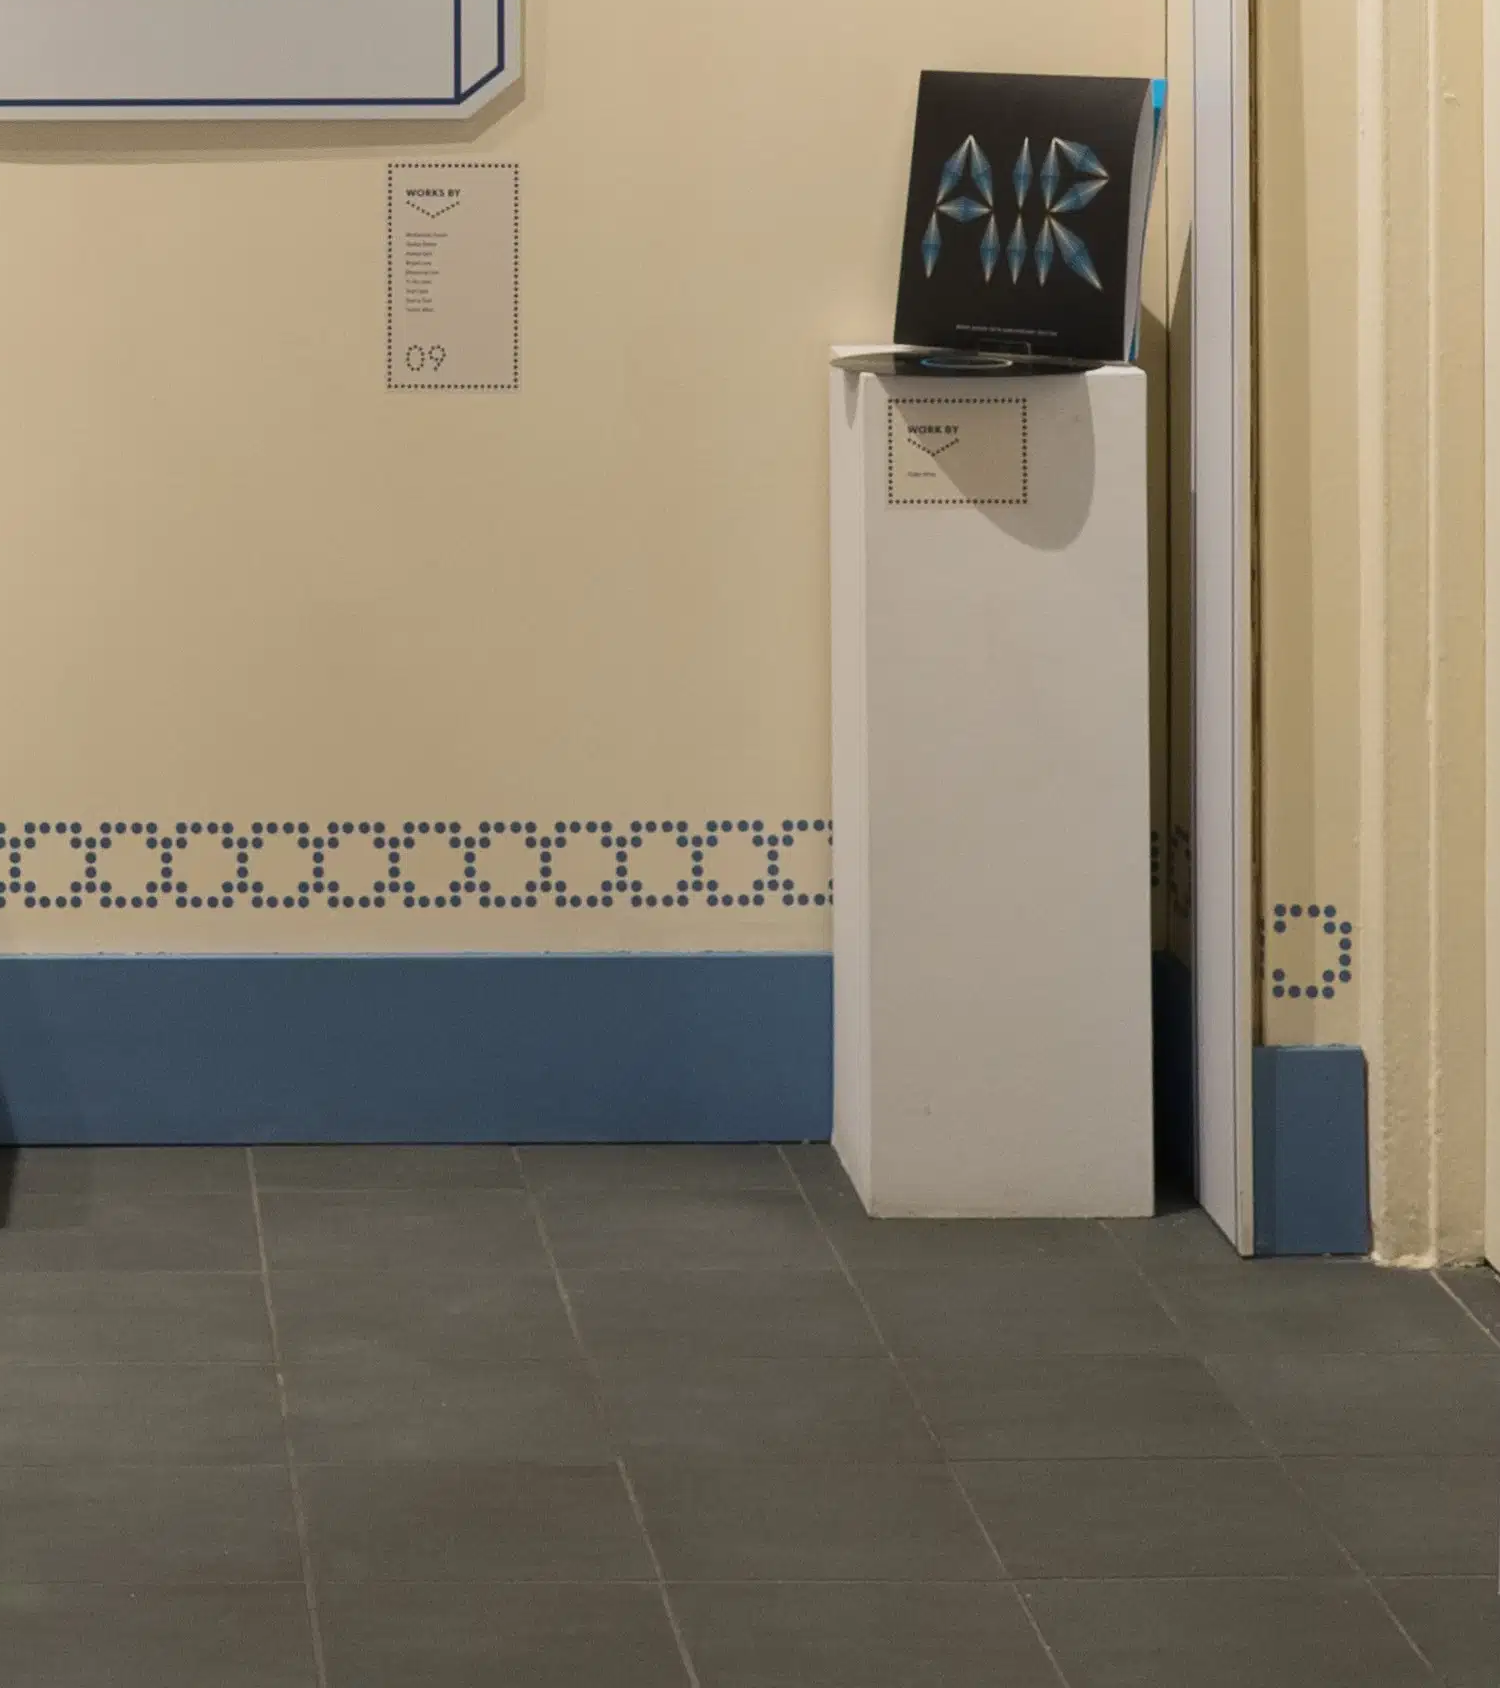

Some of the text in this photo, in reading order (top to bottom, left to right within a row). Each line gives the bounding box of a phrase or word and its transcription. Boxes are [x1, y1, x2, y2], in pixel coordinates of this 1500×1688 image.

[405, 188, 461, 198] WORKS BY
[921, 134, 1109, 292] AIR
[405, 344, 447, 372] 09
